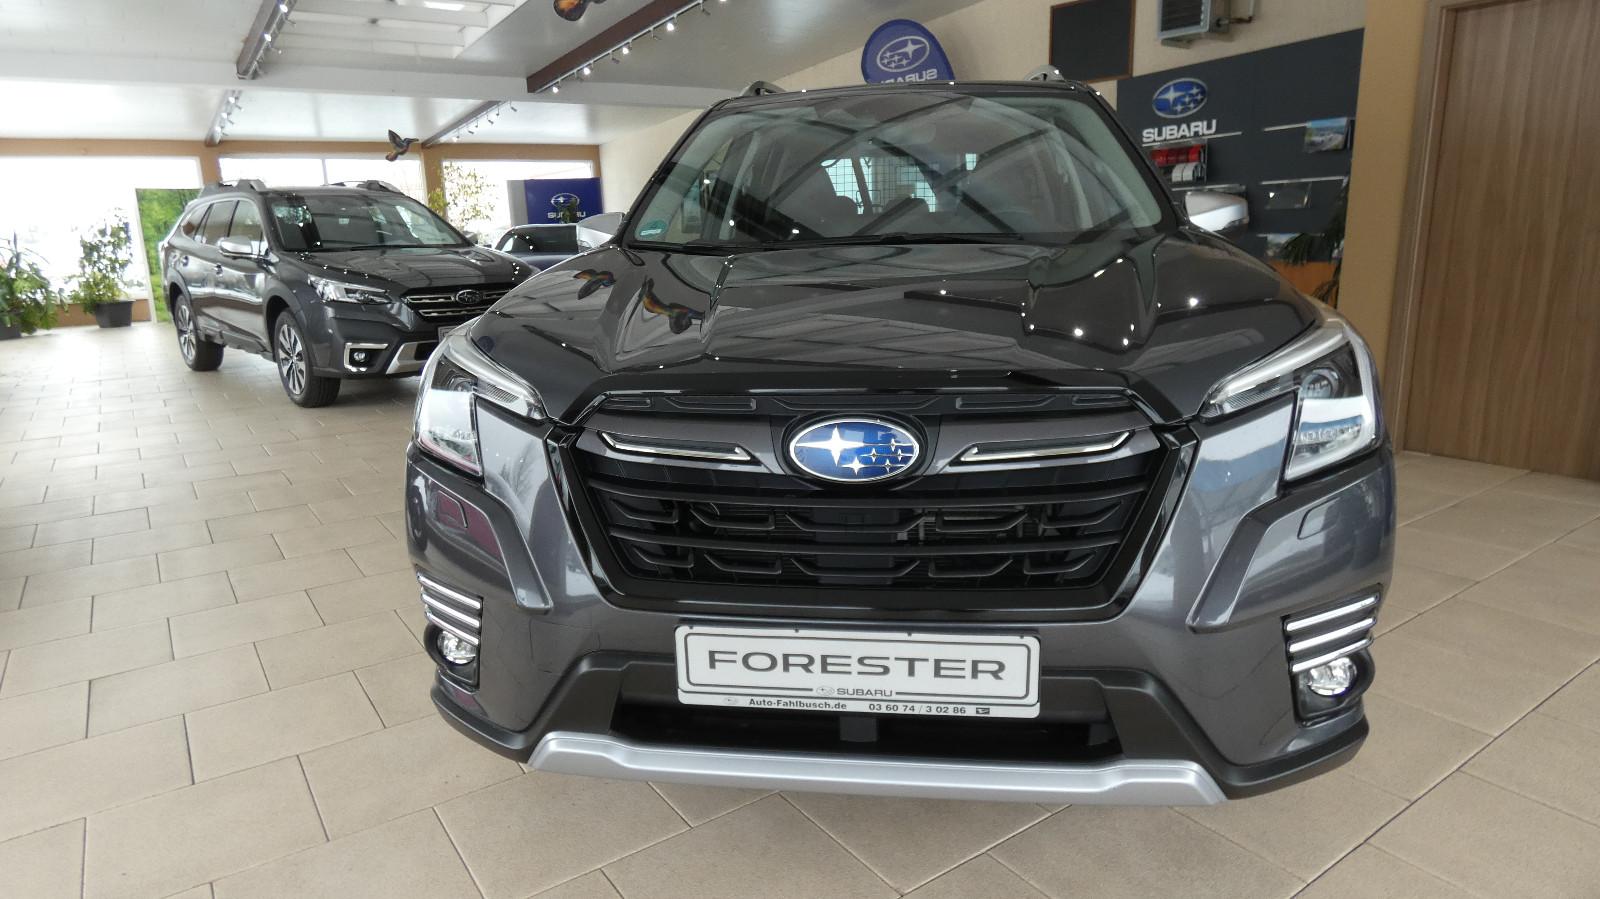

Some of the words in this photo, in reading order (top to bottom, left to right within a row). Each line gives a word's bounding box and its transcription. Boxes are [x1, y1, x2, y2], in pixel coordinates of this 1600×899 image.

[1142, 119, 1217, 142] SUBARU
[708, 650, 1006, 680] FORESTER
[837, 688, 893, 697] SUBARU
[749, 698, 847, 710] Auto-Fahlbusch.de
[869, 703, 882, 711] 03
[885, 704, 899, 712] 60
[926, 705, 932, 713] 3
[935, 706, 949, 714] 02
